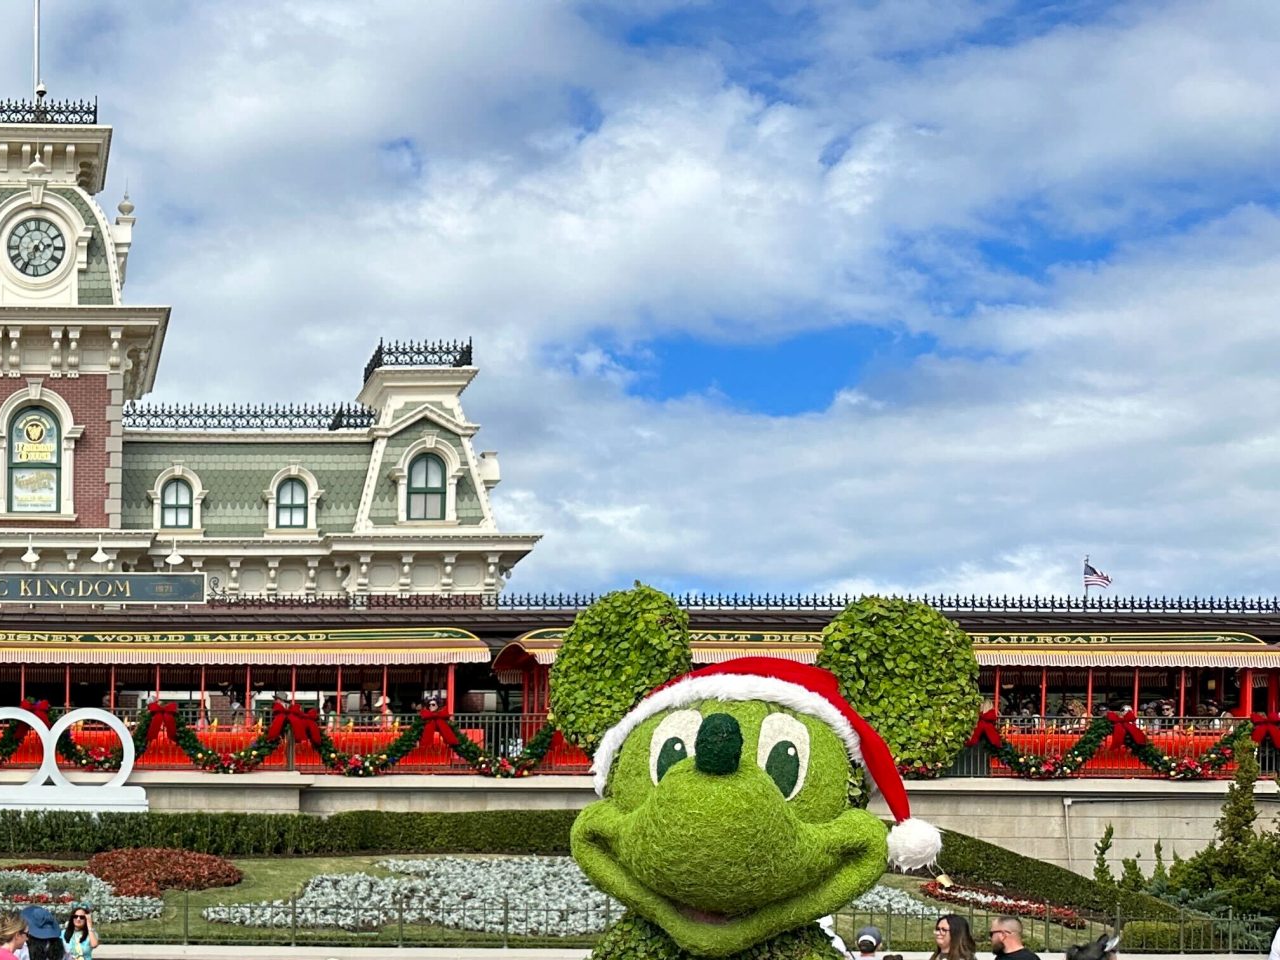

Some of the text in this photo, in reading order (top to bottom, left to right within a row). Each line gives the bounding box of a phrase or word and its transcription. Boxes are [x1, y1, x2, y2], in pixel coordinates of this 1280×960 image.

[19, 578, 131, 598] KINGDOM
[94, 634, 185, 642] WORLD
[193, 633, 326, 642] RAILROAD
[762, 634, 825, 642] DISN
[972, 635, 1108, 644] RAILROAD
